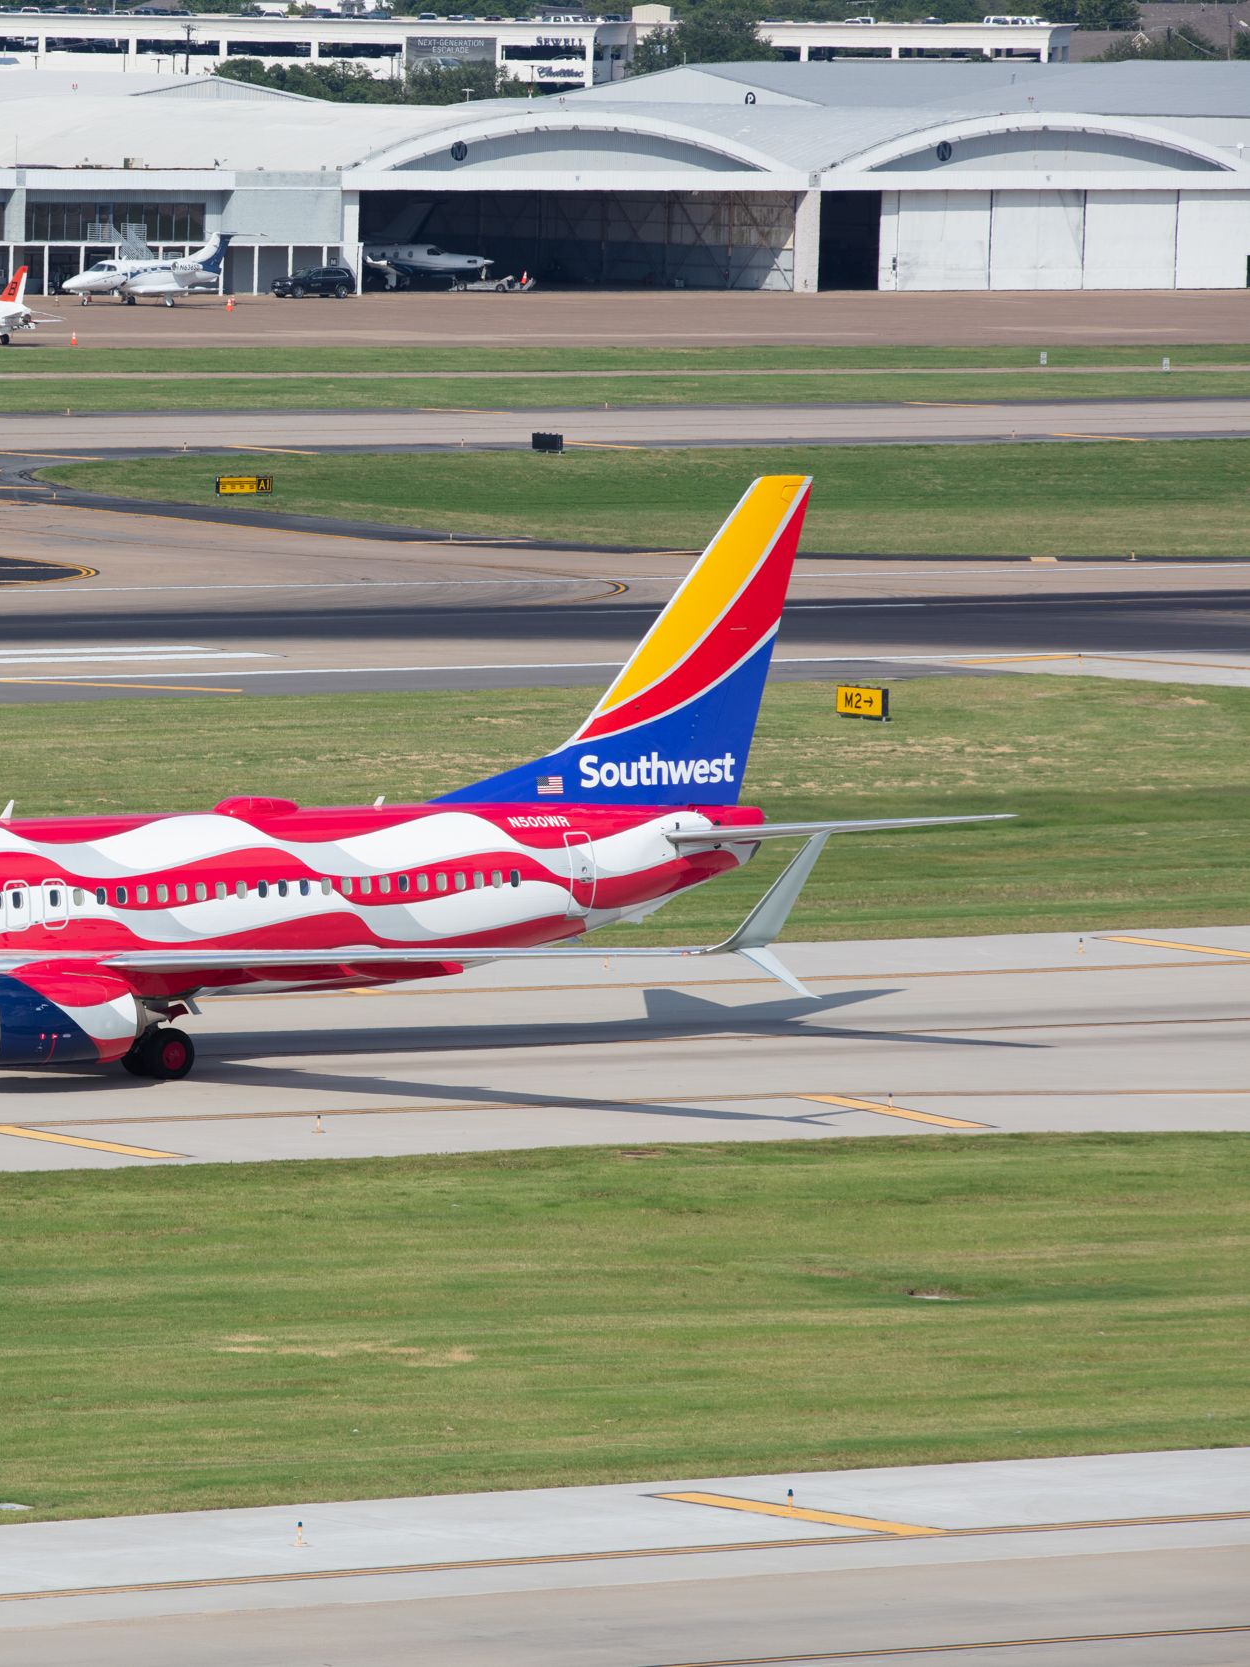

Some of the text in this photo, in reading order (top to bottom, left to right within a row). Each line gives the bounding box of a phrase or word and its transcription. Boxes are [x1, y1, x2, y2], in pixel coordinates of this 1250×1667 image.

[417, 39, 485, 47] NEXT-GENERATION
[432, 46, 470, 54] ESCALADE
[939, 143, 950, 160] N
[8, 281, 18, 296] B
[258, 479, 270, 490] A1
[844, 692, 862, 709] M2
[579, 751, 736, 789] Southwest
[507, 815, 572, 829] N500WR
